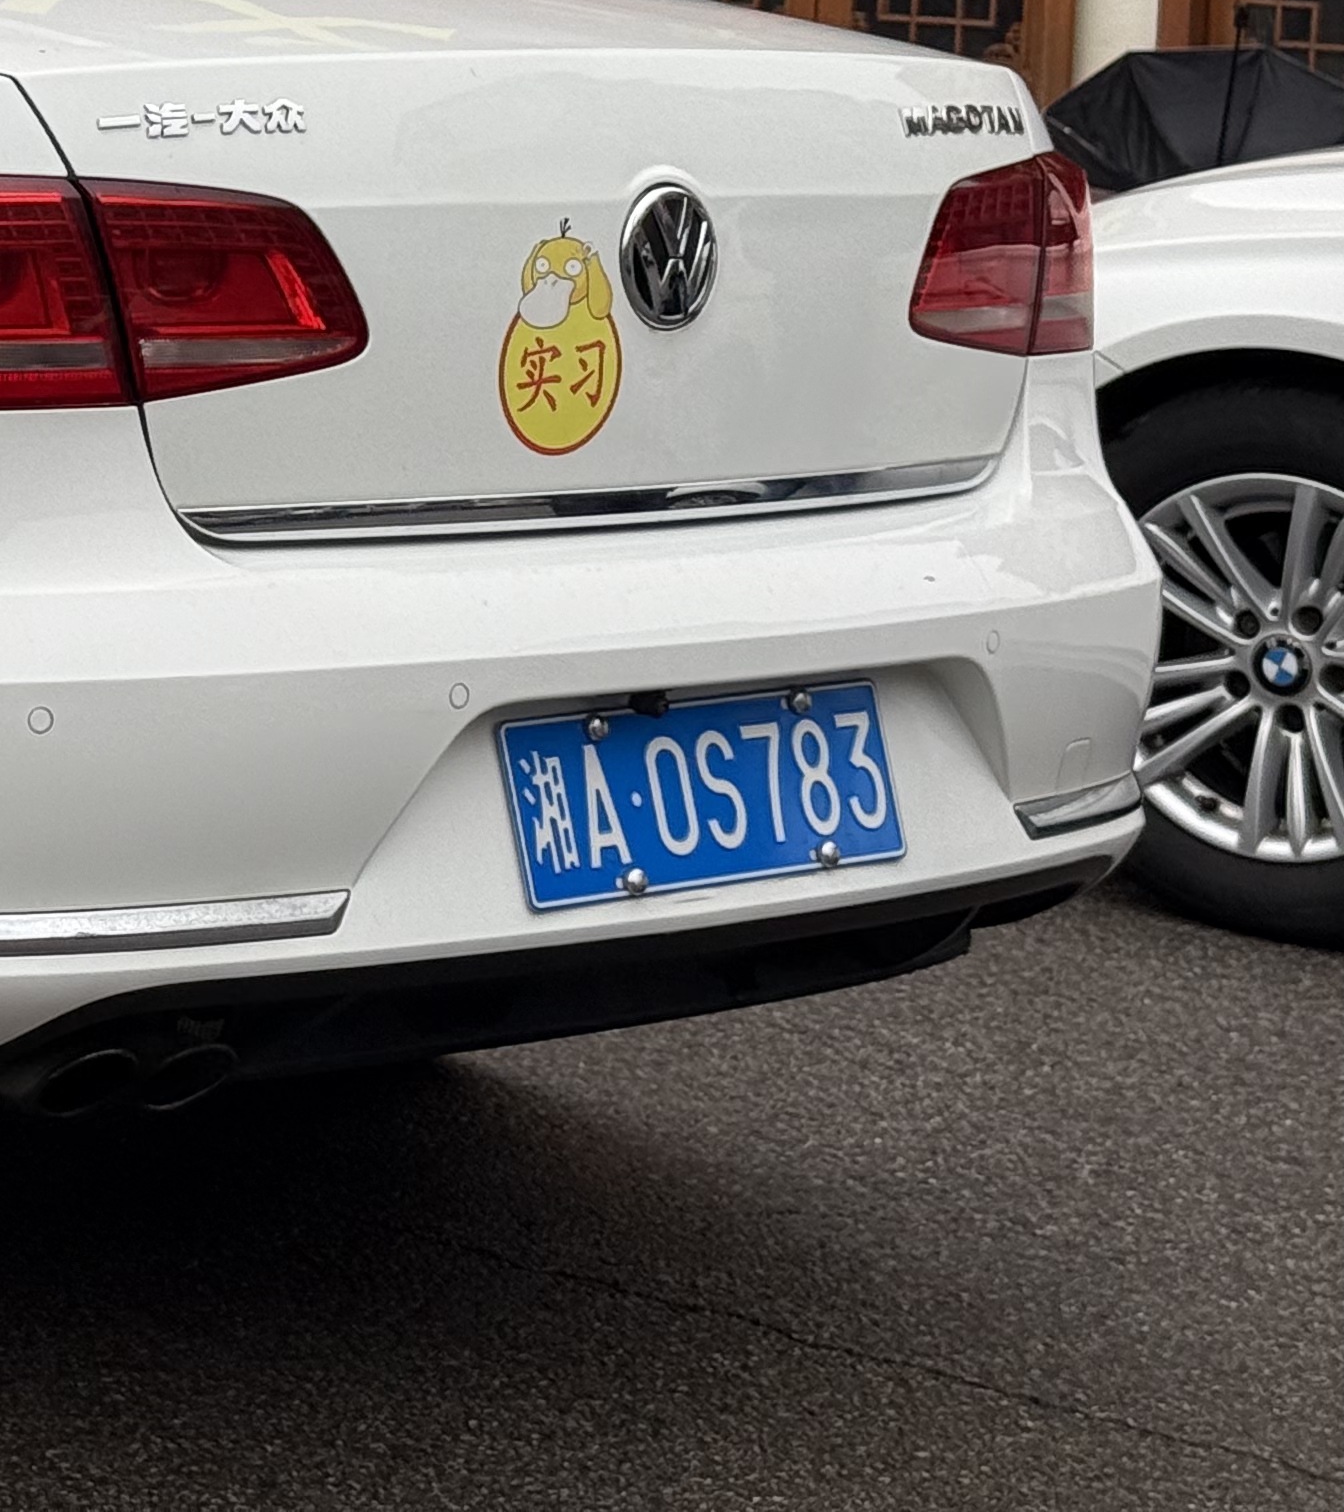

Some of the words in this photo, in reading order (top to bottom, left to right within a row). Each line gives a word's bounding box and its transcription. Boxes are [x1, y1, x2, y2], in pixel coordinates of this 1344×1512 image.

[96, 97, 307, 139] 一汽-大众
[899, 103, 1025, 138] MAGOTAN
[515, 335, 609, 413] 实习
